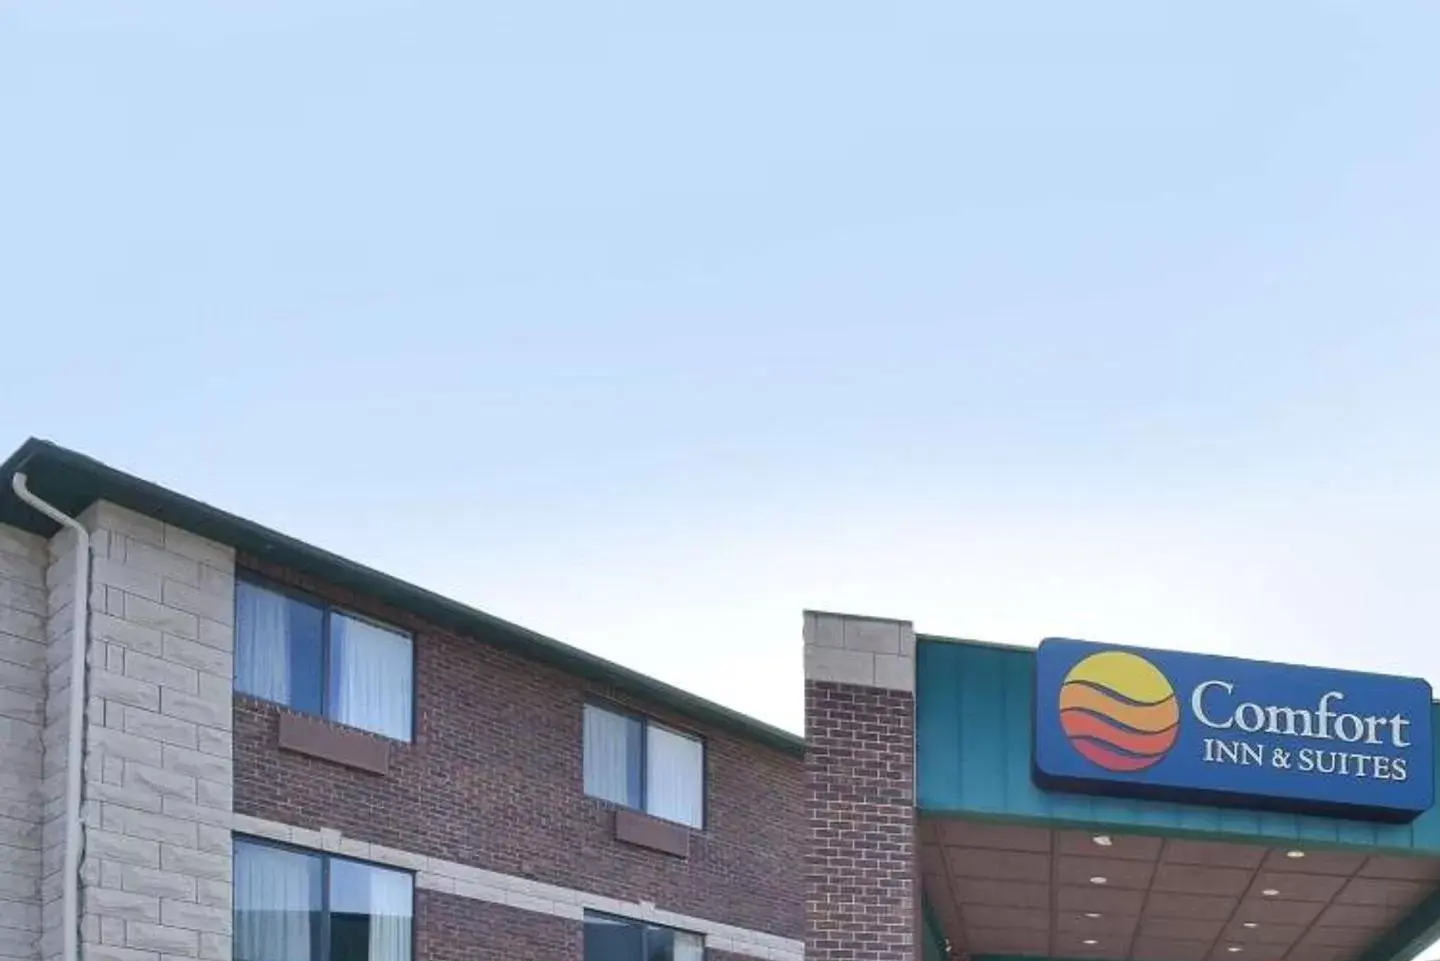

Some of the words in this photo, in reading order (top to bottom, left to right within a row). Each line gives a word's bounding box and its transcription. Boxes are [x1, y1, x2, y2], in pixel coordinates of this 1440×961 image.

[1191, 680, 1411, 748] Comfort
[1203, 738, 1263, 766] INN
[1272, 748, 1291, 769] &
[1299, 749, 1407, 781] SUITES
